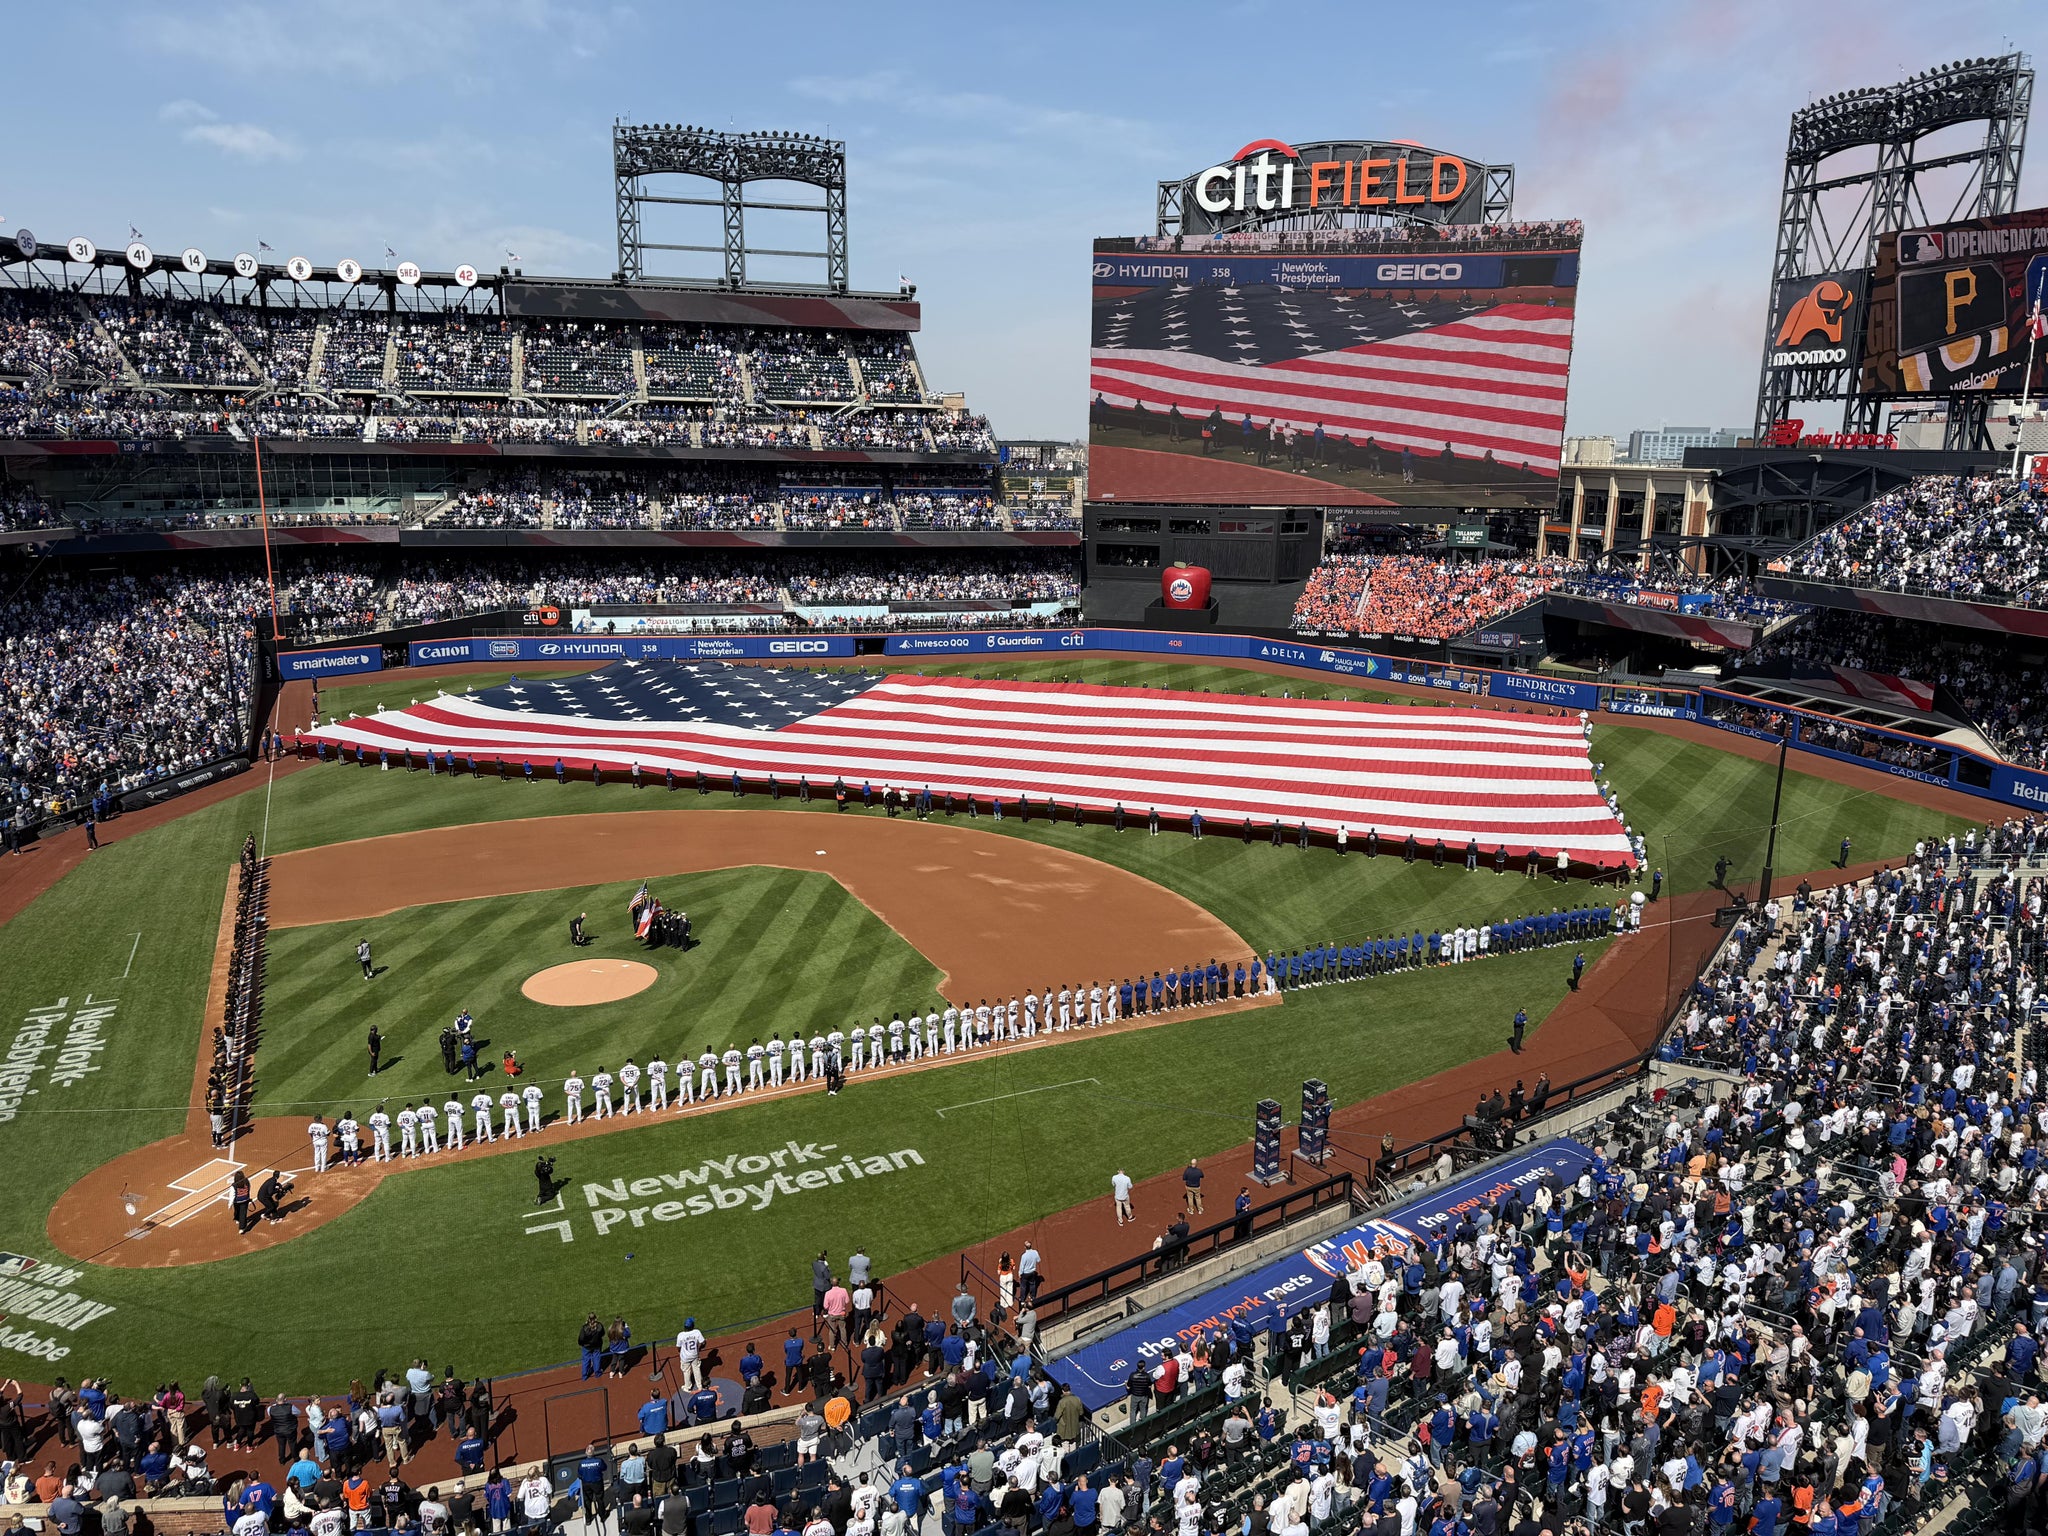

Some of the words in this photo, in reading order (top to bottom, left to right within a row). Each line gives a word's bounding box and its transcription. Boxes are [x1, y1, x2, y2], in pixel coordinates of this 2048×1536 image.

[1196, 152, 1294, 213] citi
[1310, 155, 1467, 208] FIELD
[1285, 232, 1304, 240] FIEST
[1314, 231, 1333, 240] DEC
[21, 236, 33, 249] 36
[75, 243, 89, 256] 31
[133, 249, 146, 262] 41
[188, 254, 201, 266] 14
[239, 259, 253, 271] 37
[1281, 262, 1328, 273] NewYork-
[400, 269, 418, 278] SHEA
[459, 270, 473, 281] 42
[1119, 265, 1188, 279] HYUNDAI
[1212, 268, 1231, 278] 358
[1377, 263, 1463, 281] GEICO
[1281, 273, 1340, 285] Presbyterian
[1773, 349, 1846, 367] moomoo
[1804, 433, 1832, 445] new
[1834, 431, 1893, 446] balance
[523, 612, 539, 622] citi
[698, 640, 733, 648] NewYork-
[914, 639, 949, 648] Invesco
[950, 638, 969, 648] QQQ
[997, 636, 1043, 646] Guardian
[1061, 634, 1084, 646] citi
[419, 645, 469, 659] Canon
[564, 644, 622, 654] HYUNDAI
[698, 647, 744, 656] Presbyterian
[769, 641, 829, 653] GEICO
[1272, 647, 1305, 660] DELTA
[293, 655, 360, 670] smartwater
[1335, 658, 1366, 668] HAUGLAND
[1335, 664, 1354, 673] GROUP
[1389, 672, 1403, 681] 380
[1408, 674, 1426, 683] GOYA
[1433, 678, 1451, 687] GOYA
[1507, 677, 1576, 696] HENDRICK'S
[1633, 704, 1677, 717] DUNKIN'
[1686, 709, 1697, 720] 370
[1717, 721, 1762, 739] CADILLAC
[1890, 765, 1950, 788] CADILLAC
[50, 1005, 118, 1087] NewYork-
[582, 1140, 838, 1207] NewYork-
[591, 1148, 926, 1236] Presbyterian
[1417, 1211, 1449, 1228] the
[1447, 1196, 1481, 1216] new
[1481, 1182, 1517, 1200] york
[1511, 1165, 1549, 1187] mets
[1341, 1231, 1409, 1271] Mets
[20, 1263, 84, 1288] 2026
[1512, 1285, 1517, 1294] 9
[1137, 1336, 1177, 1358] the
[1176, 1313, 1220, 1342] new
[1219, 1295, 1267, 1320] york
[1263, 1273, 1313, 1301] mets
[684, 1340, 696, 1351] 12
[1292, 1339, 1302, 1348] 21
[1109, 1359, 1128, 1371] citi
[1231, 1376, 1242, 1386] 22
[1690, 1374, 1695, 1385] 5
[1028, 1447, 1038, 1456] 18
[249, 1490, 263, 1503] 17
[386, 1492, 399, 1503] 31
[529, 1488, 540, 1499] 12
[863, 1500, 871, 1510] 5
[423, 1514, 433, 1525] 12
[1189, 1516, 1199, 1527] 10
[1217, 1514, 1224, 1525] 5
[244, 1525, 260, 1536] 22
[322, 1522, 334, 1534] 18
